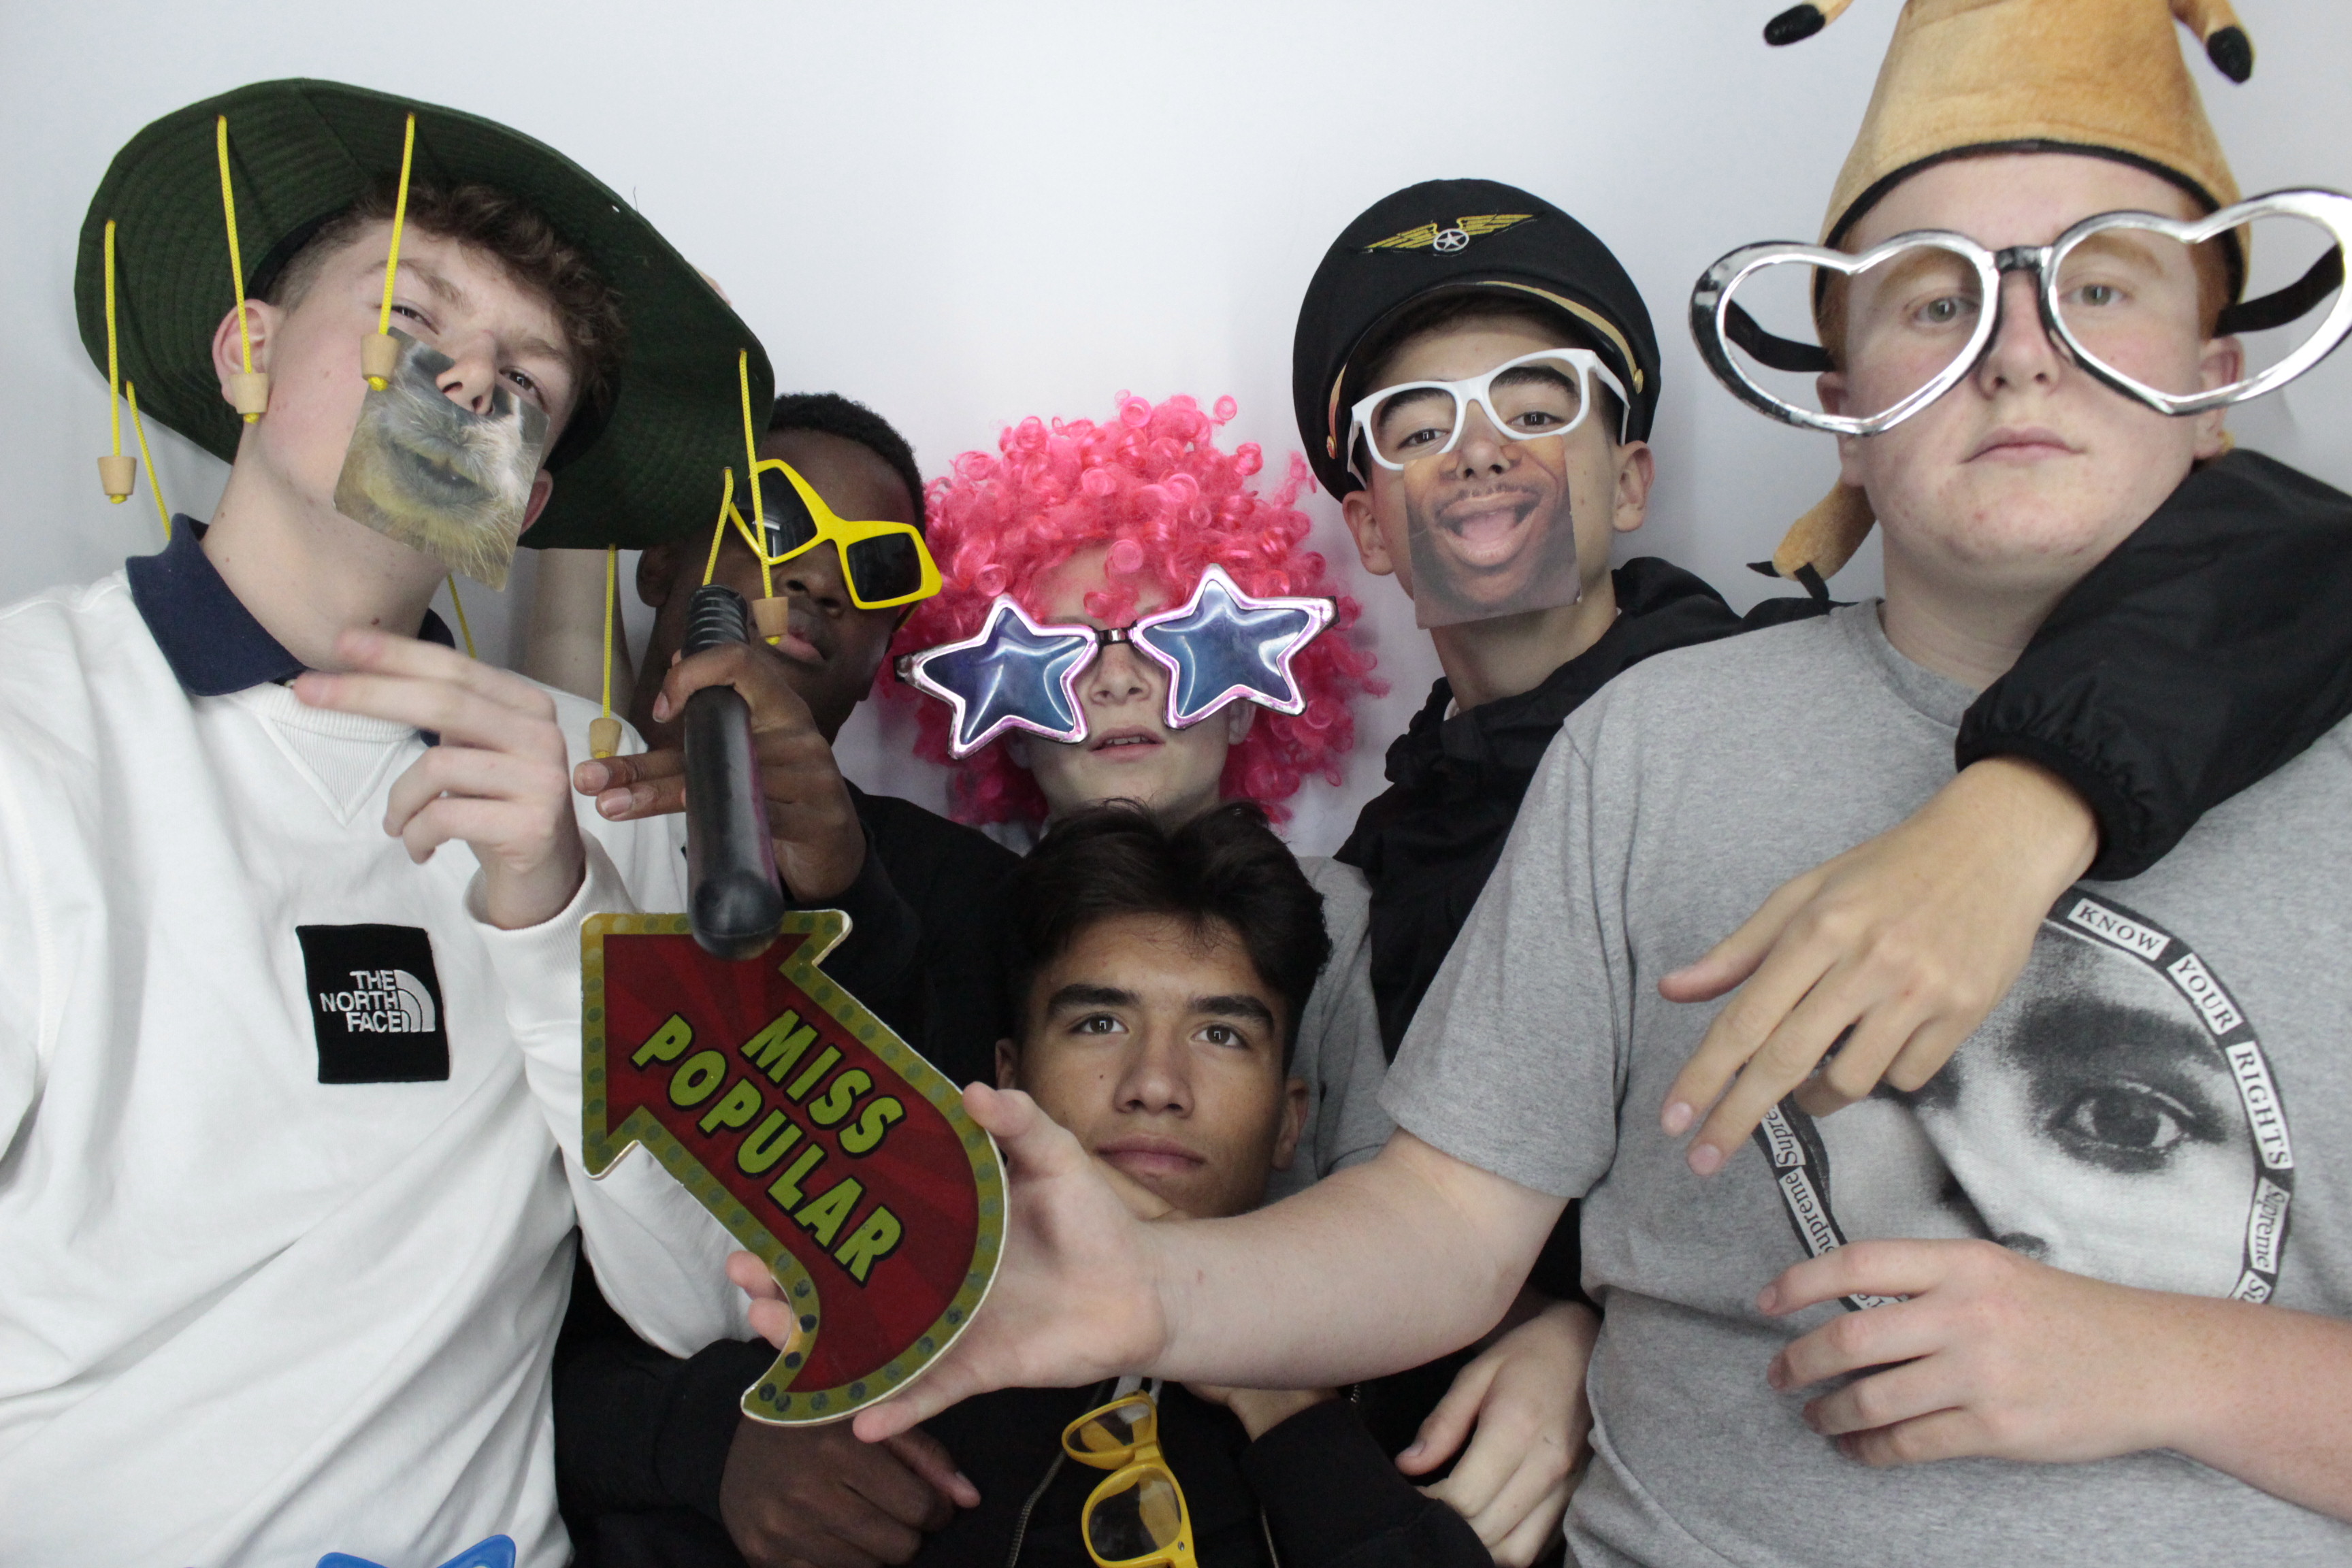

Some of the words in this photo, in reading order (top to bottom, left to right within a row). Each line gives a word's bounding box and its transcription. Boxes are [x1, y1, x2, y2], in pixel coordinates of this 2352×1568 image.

[320, 990, 399, 1012] NORTH
[349, 969, 396, 990] THE
[346, 1011, 402, 1033] FACE
[2078, 905, 2161, 951] KNOW
[2177, 958, 2234, 1028] YOUR
[2235, 1051, 2289, 1164] RIGHTS
[738, 1007, 906, 1157] MISS
[630, 1012, 902, 1285] POPULAR
[1765, 1107, 1798, 1165] Supre
